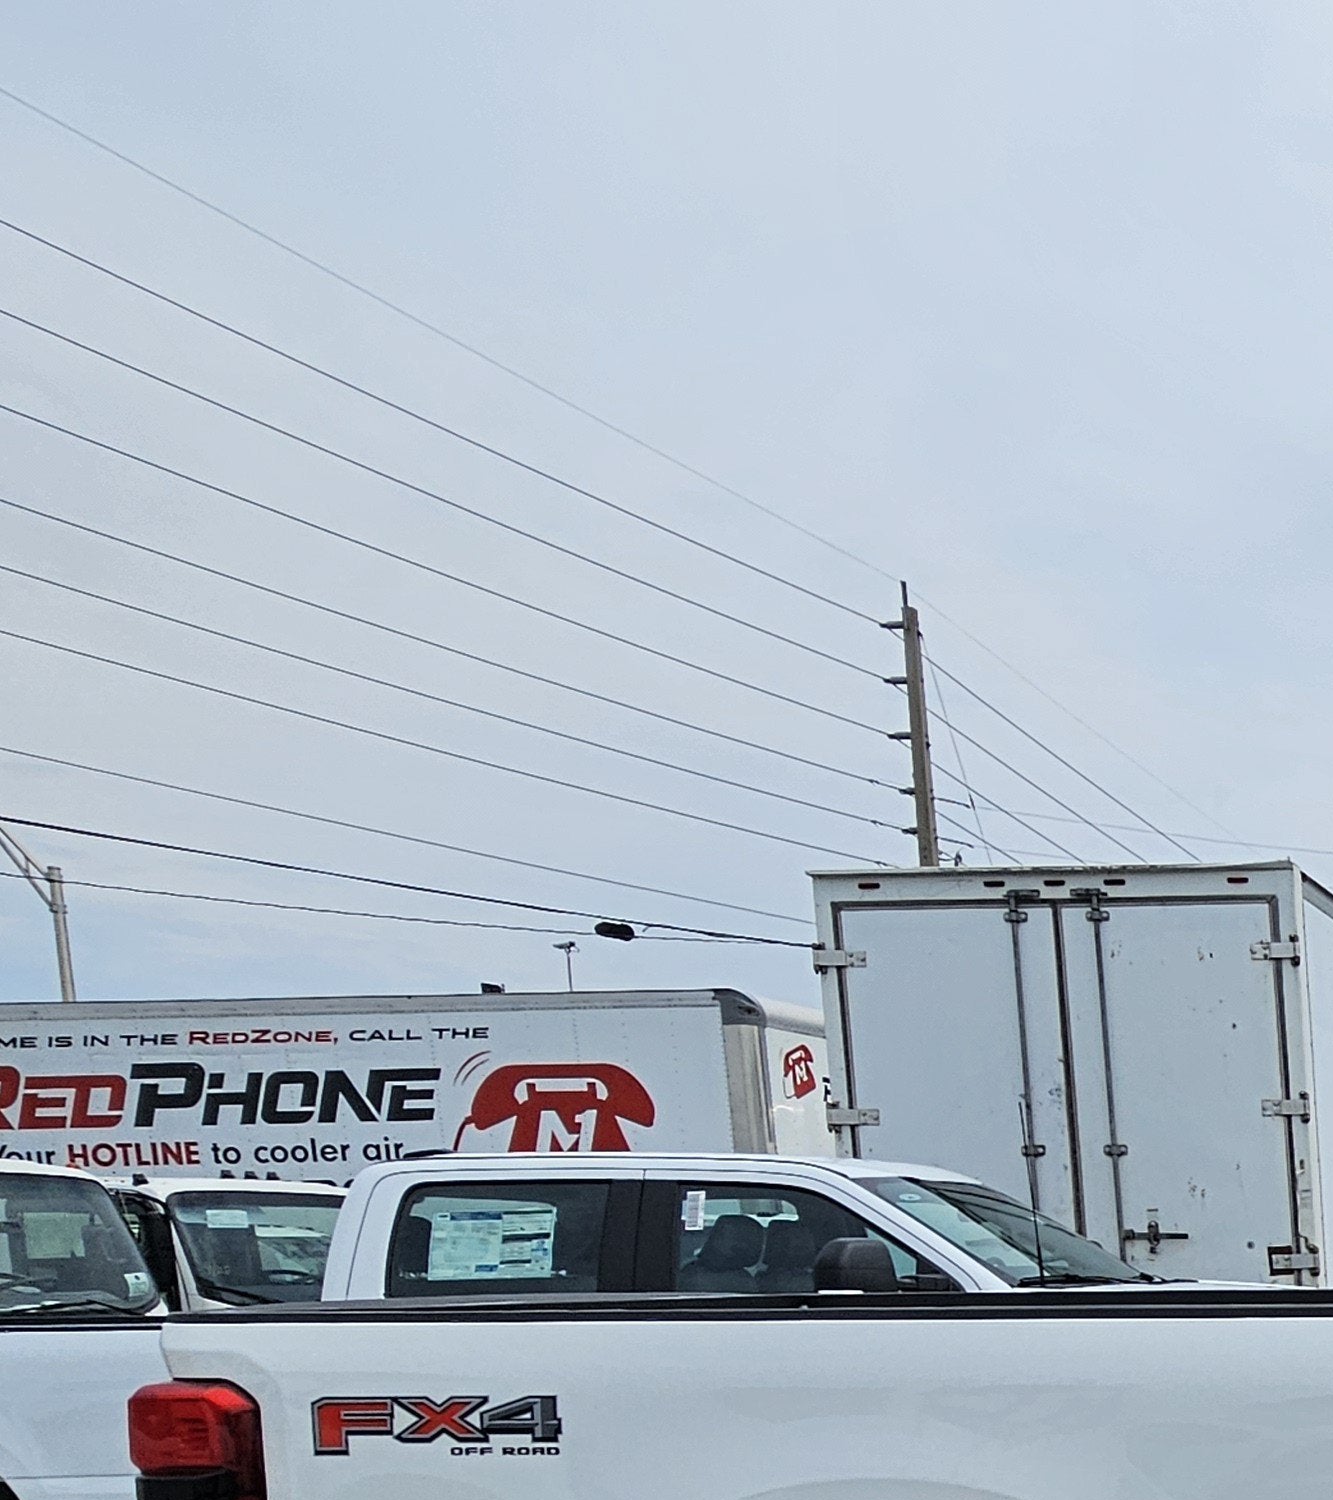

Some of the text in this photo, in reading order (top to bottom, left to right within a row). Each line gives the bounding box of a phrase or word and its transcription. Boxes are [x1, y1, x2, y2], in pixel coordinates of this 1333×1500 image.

[48, 1036, 73, 1047] IS
[83, 1035, 111, 1047] IN
[119, 1034, 179, 1045] THE
[349, 1029, 422, 1042] CALL
[431, 1027, 489, 1039] THE
[67, 1141, 201, 1167] HOTLINE
[211, 1143, 241, 1164] to
[254, 1138, 350, 1163] cooler
[362, 1136, 404, 1161] air
[311, 1396, 562, 1456] FX4
[450, 1446, 560, 1456] OFF ROAD
